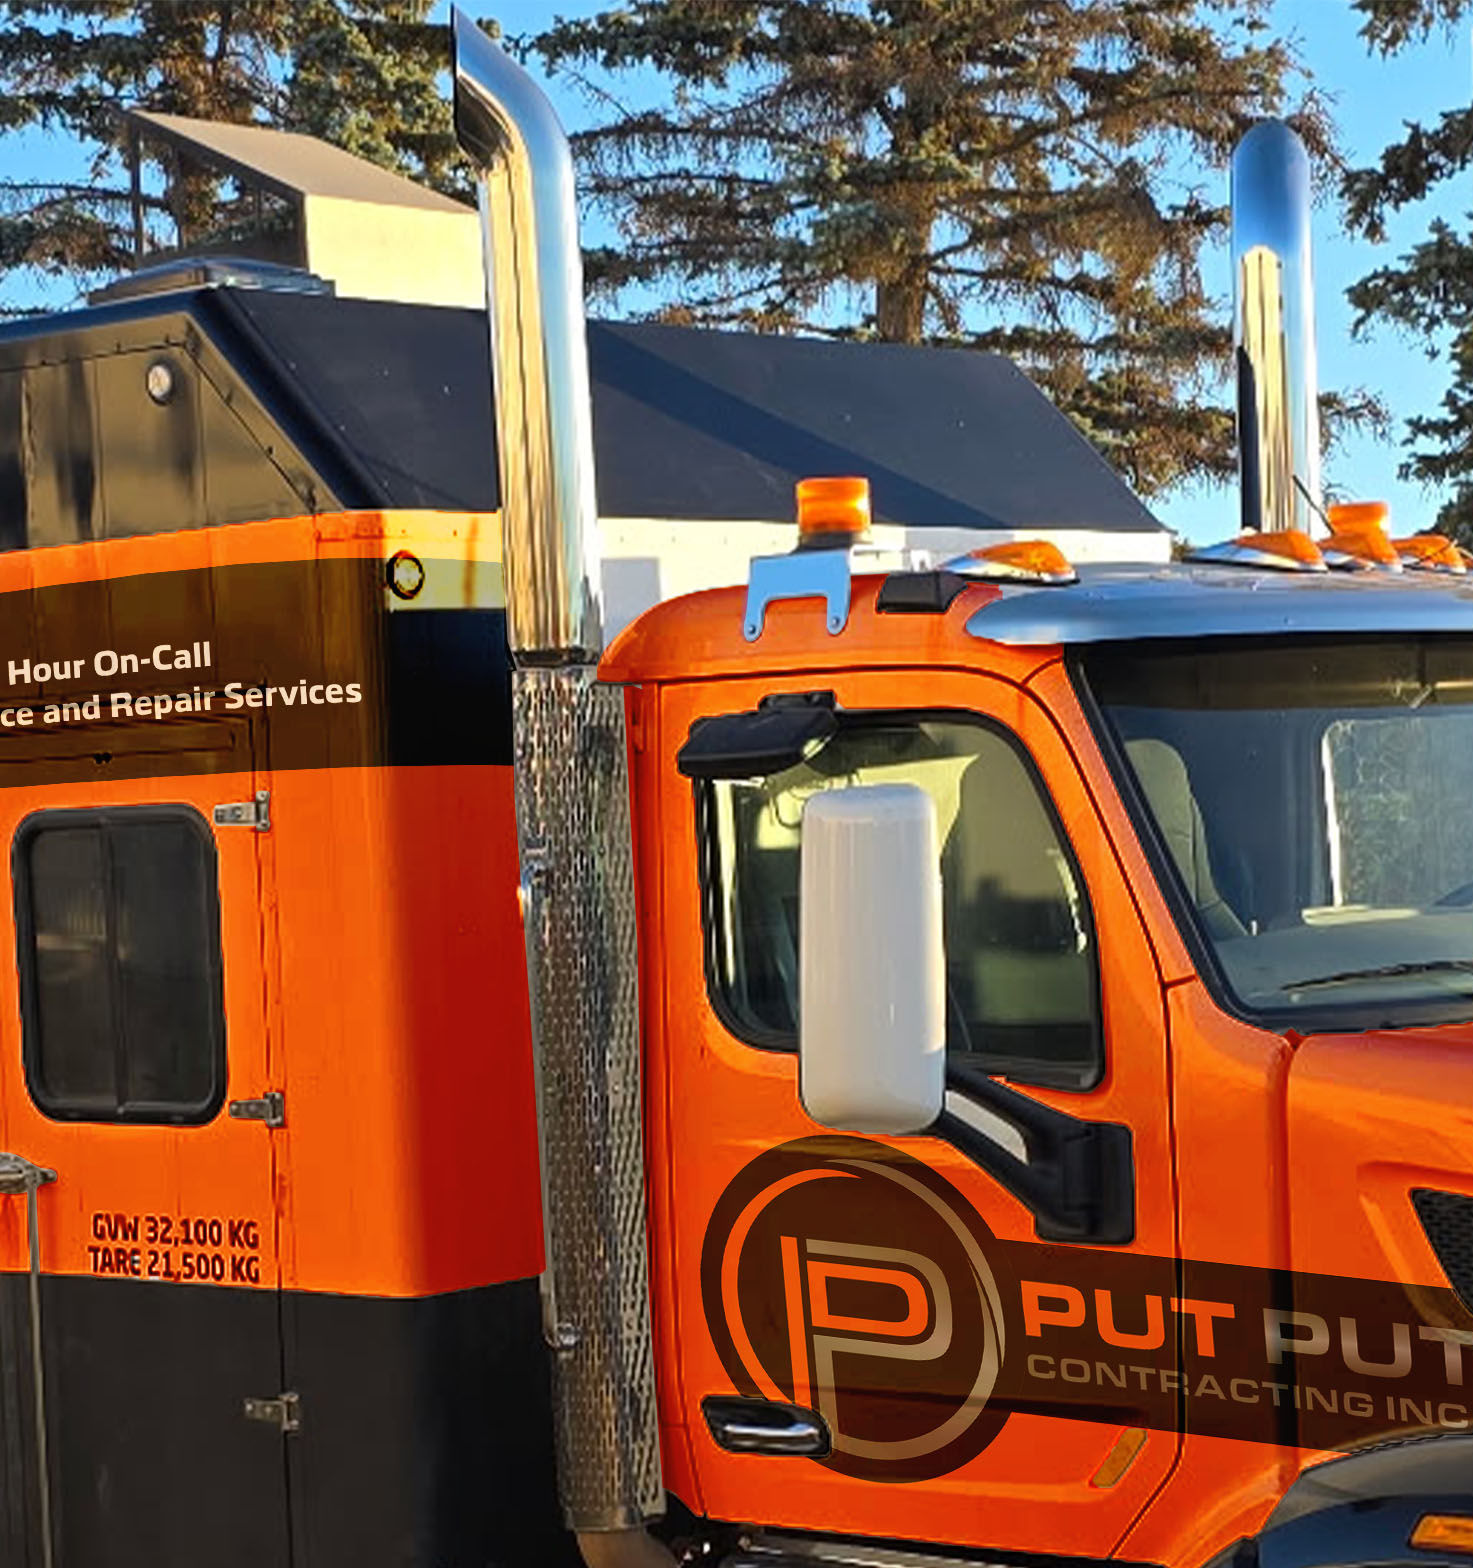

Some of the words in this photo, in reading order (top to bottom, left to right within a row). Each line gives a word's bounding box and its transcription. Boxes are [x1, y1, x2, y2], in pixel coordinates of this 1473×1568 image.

[7, 658, 86, 686] Hour
[93, 640, 212, 677] On-Call
[43, 694, 101, 724] and
[110, 686, 216, 720] Repair
[224, 679, 363, 710] Services
[92, 1212, 140, 1243] GVW
[144, 1215, 223, 1248] 32,100
[228, 1218, 260, 1250] KG
[87, 1245, 141, 1276] TARE
[147, 1250, 225, 1282] 21,500
[230, 1254, 260, 1284] KG
[1020, 1279, 1235, 1358] PUT
[1026, 1354, 1375, 1418] CONTRACTING
[1386, 1395, 1470, 1429] INC
